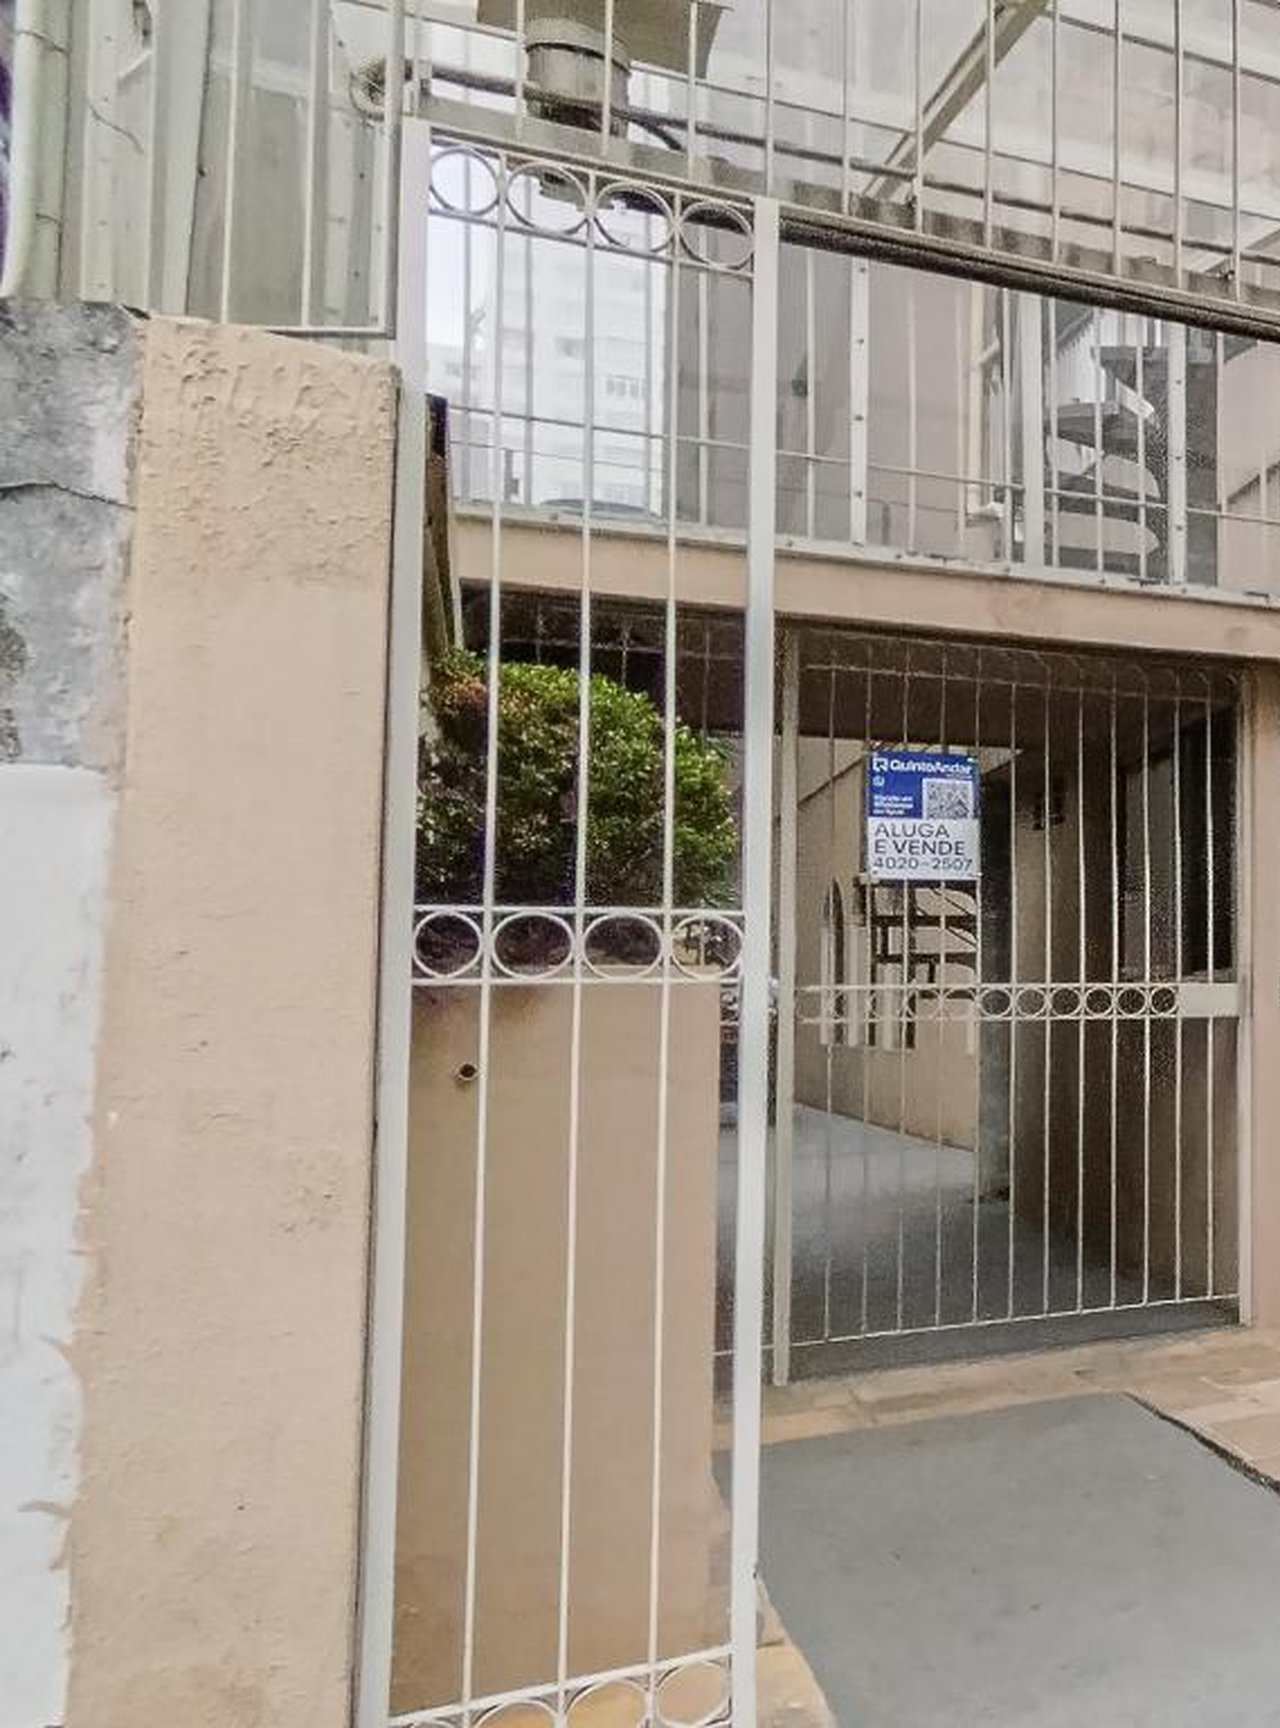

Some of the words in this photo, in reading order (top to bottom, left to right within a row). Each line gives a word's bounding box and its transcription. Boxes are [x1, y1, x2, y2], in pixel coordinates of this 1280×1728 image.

[890, 759, 972, 774] QuintoAndar
[874, 823, 950, 838] ALUGA
[874, 838, 887, 854] E
[893, 840, 966, 856] VENDE
